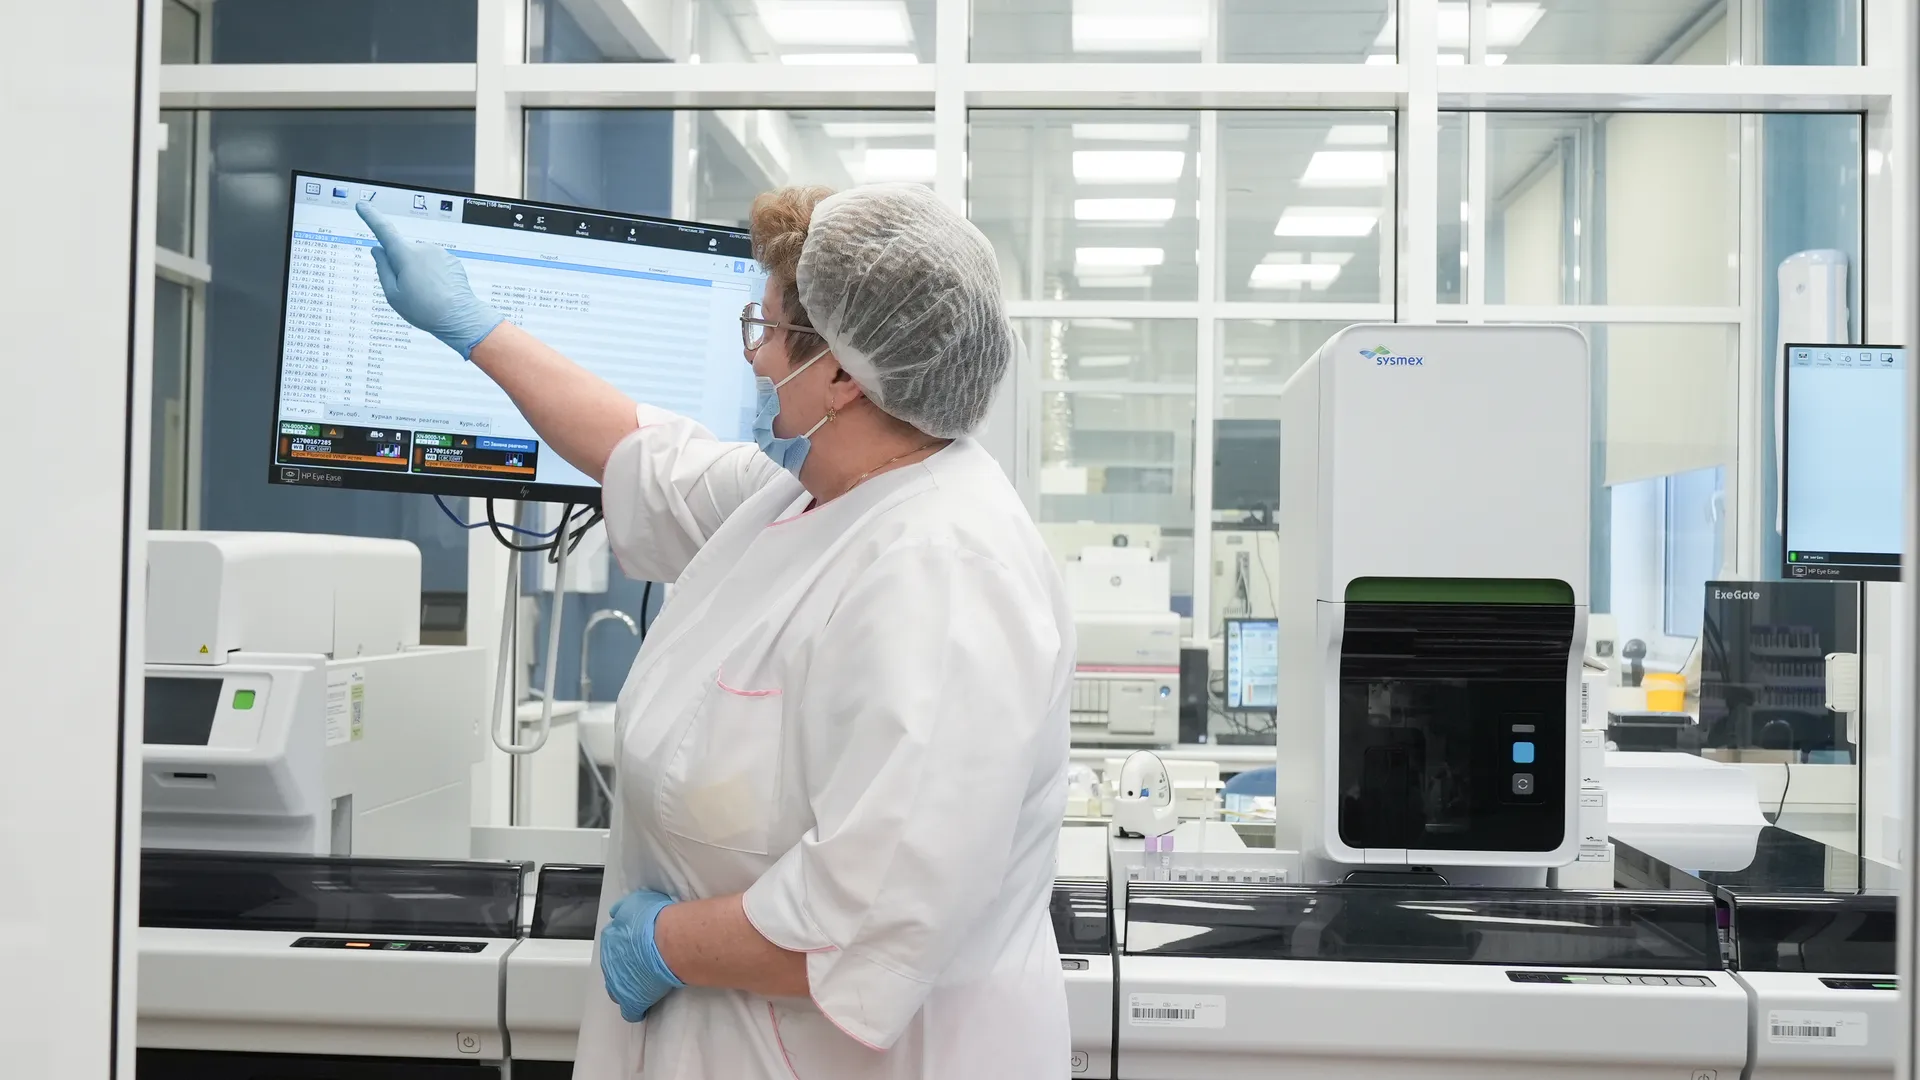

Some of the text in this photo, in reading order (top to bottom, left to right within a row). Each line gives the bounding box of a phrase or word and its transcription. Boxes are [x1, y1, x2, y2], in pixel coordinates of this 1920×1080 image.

[1376, 356, 1423, 368] sysmex
[313, 473, 324, 481] Eye
[1714, 590, 1760, 600] ExeGate
